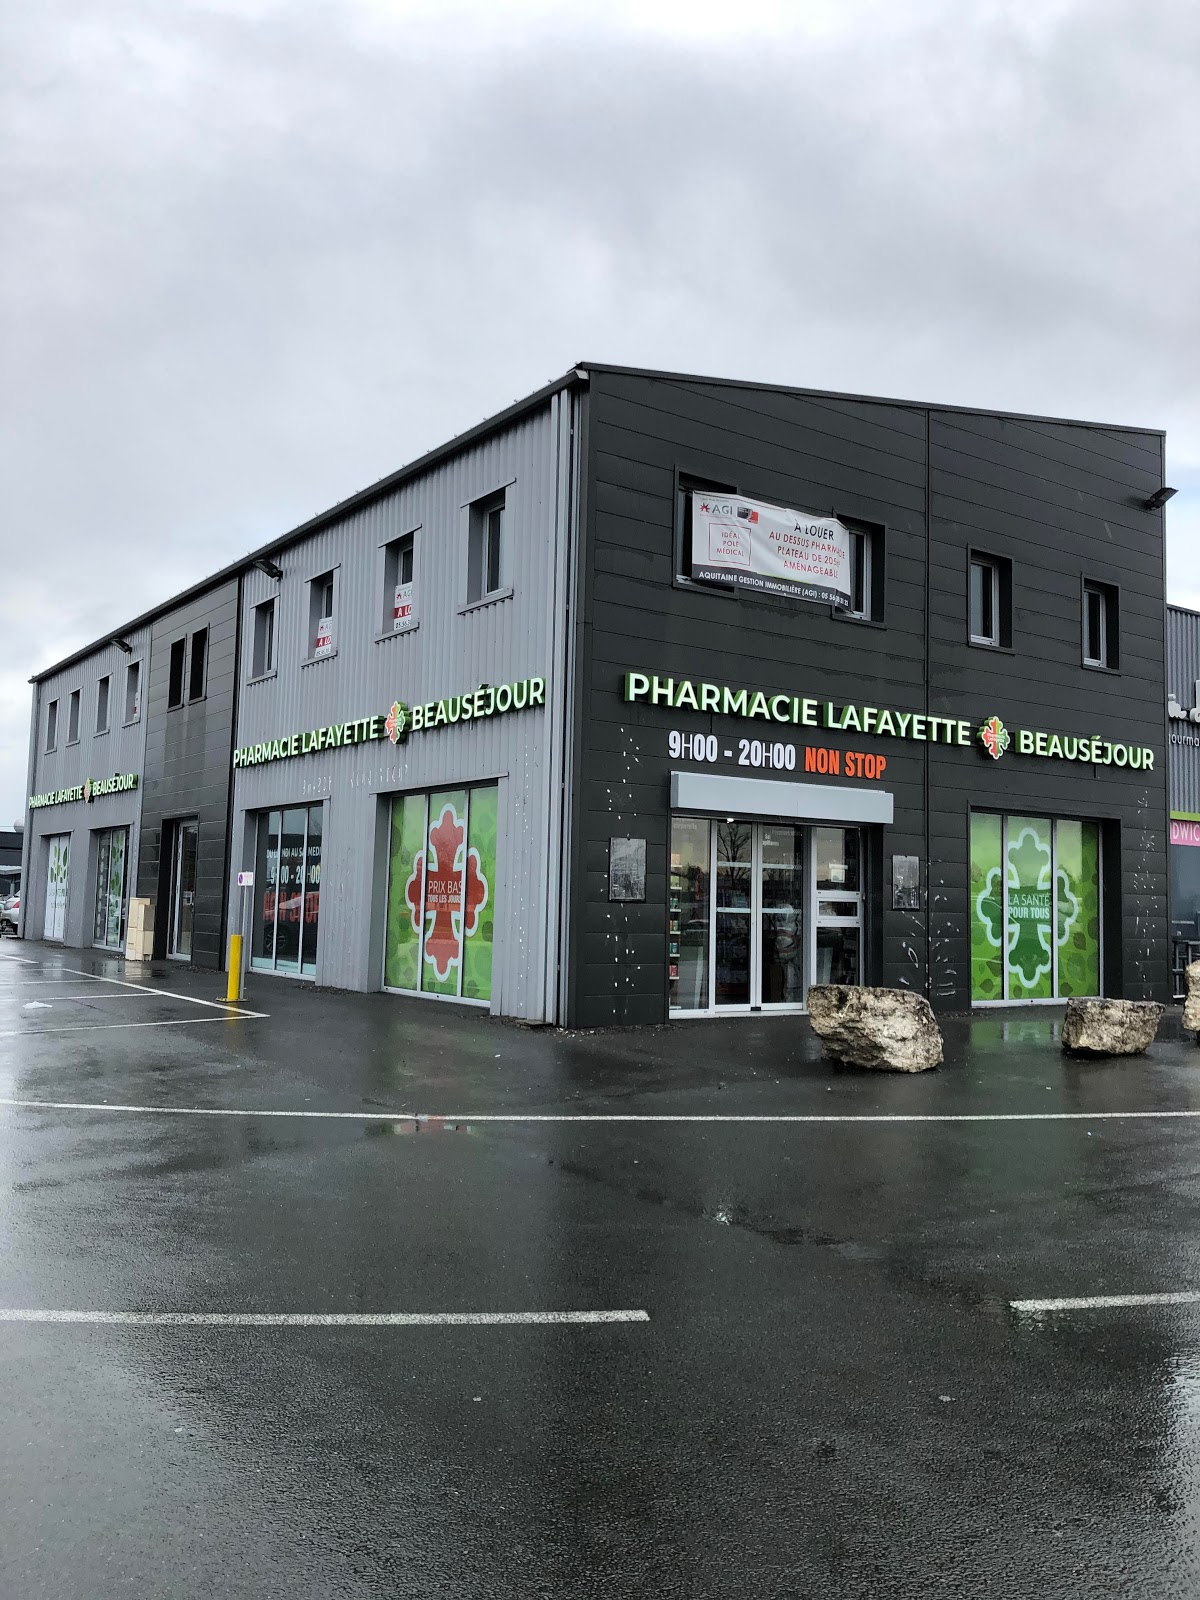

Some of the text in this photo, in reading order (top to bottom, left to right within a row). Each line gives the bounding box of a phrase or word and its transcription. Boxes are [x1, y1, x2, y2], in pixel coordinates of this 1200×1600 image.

[712, 505, 733, 515] AGI
[769, 531, 781, 541] AU
[783, 534, 809, 548] DESSUS
[805, 524, 834, 541] LOUER
[777, 545, 809, 561] PLATEAU
[812, 553, 822, 563] DE
[698, 571, 737, 582] AQUITAINE
[738, 575, 764, 588] GESTION
[764, 581, 801, 595] IMMOBILIÈRE
[802, 588, 818, 599] (AGI)
[233, 677, 544, 768] PHARMACIE LAFAYETTE BEAUSÉJOUR
[626, 672, 1154, 770] PHARMACIE LAFAYETTE BEAUSÉJOUR
[668, 730, 718, 762] 9H00
[738, 739, 796, 771] 20H00
[805, 746, 840, 775] NON
[845, 751, 886, 779] STOP
[274, 847, 290, 858] LNDI
[270, 865, 289, 884] 900
[428, 880, 445, 893] PRIX
[1008, 893, 1050, 906] LA SANTÉ
[1008, 906, 1050, 919] POUR TOUS
